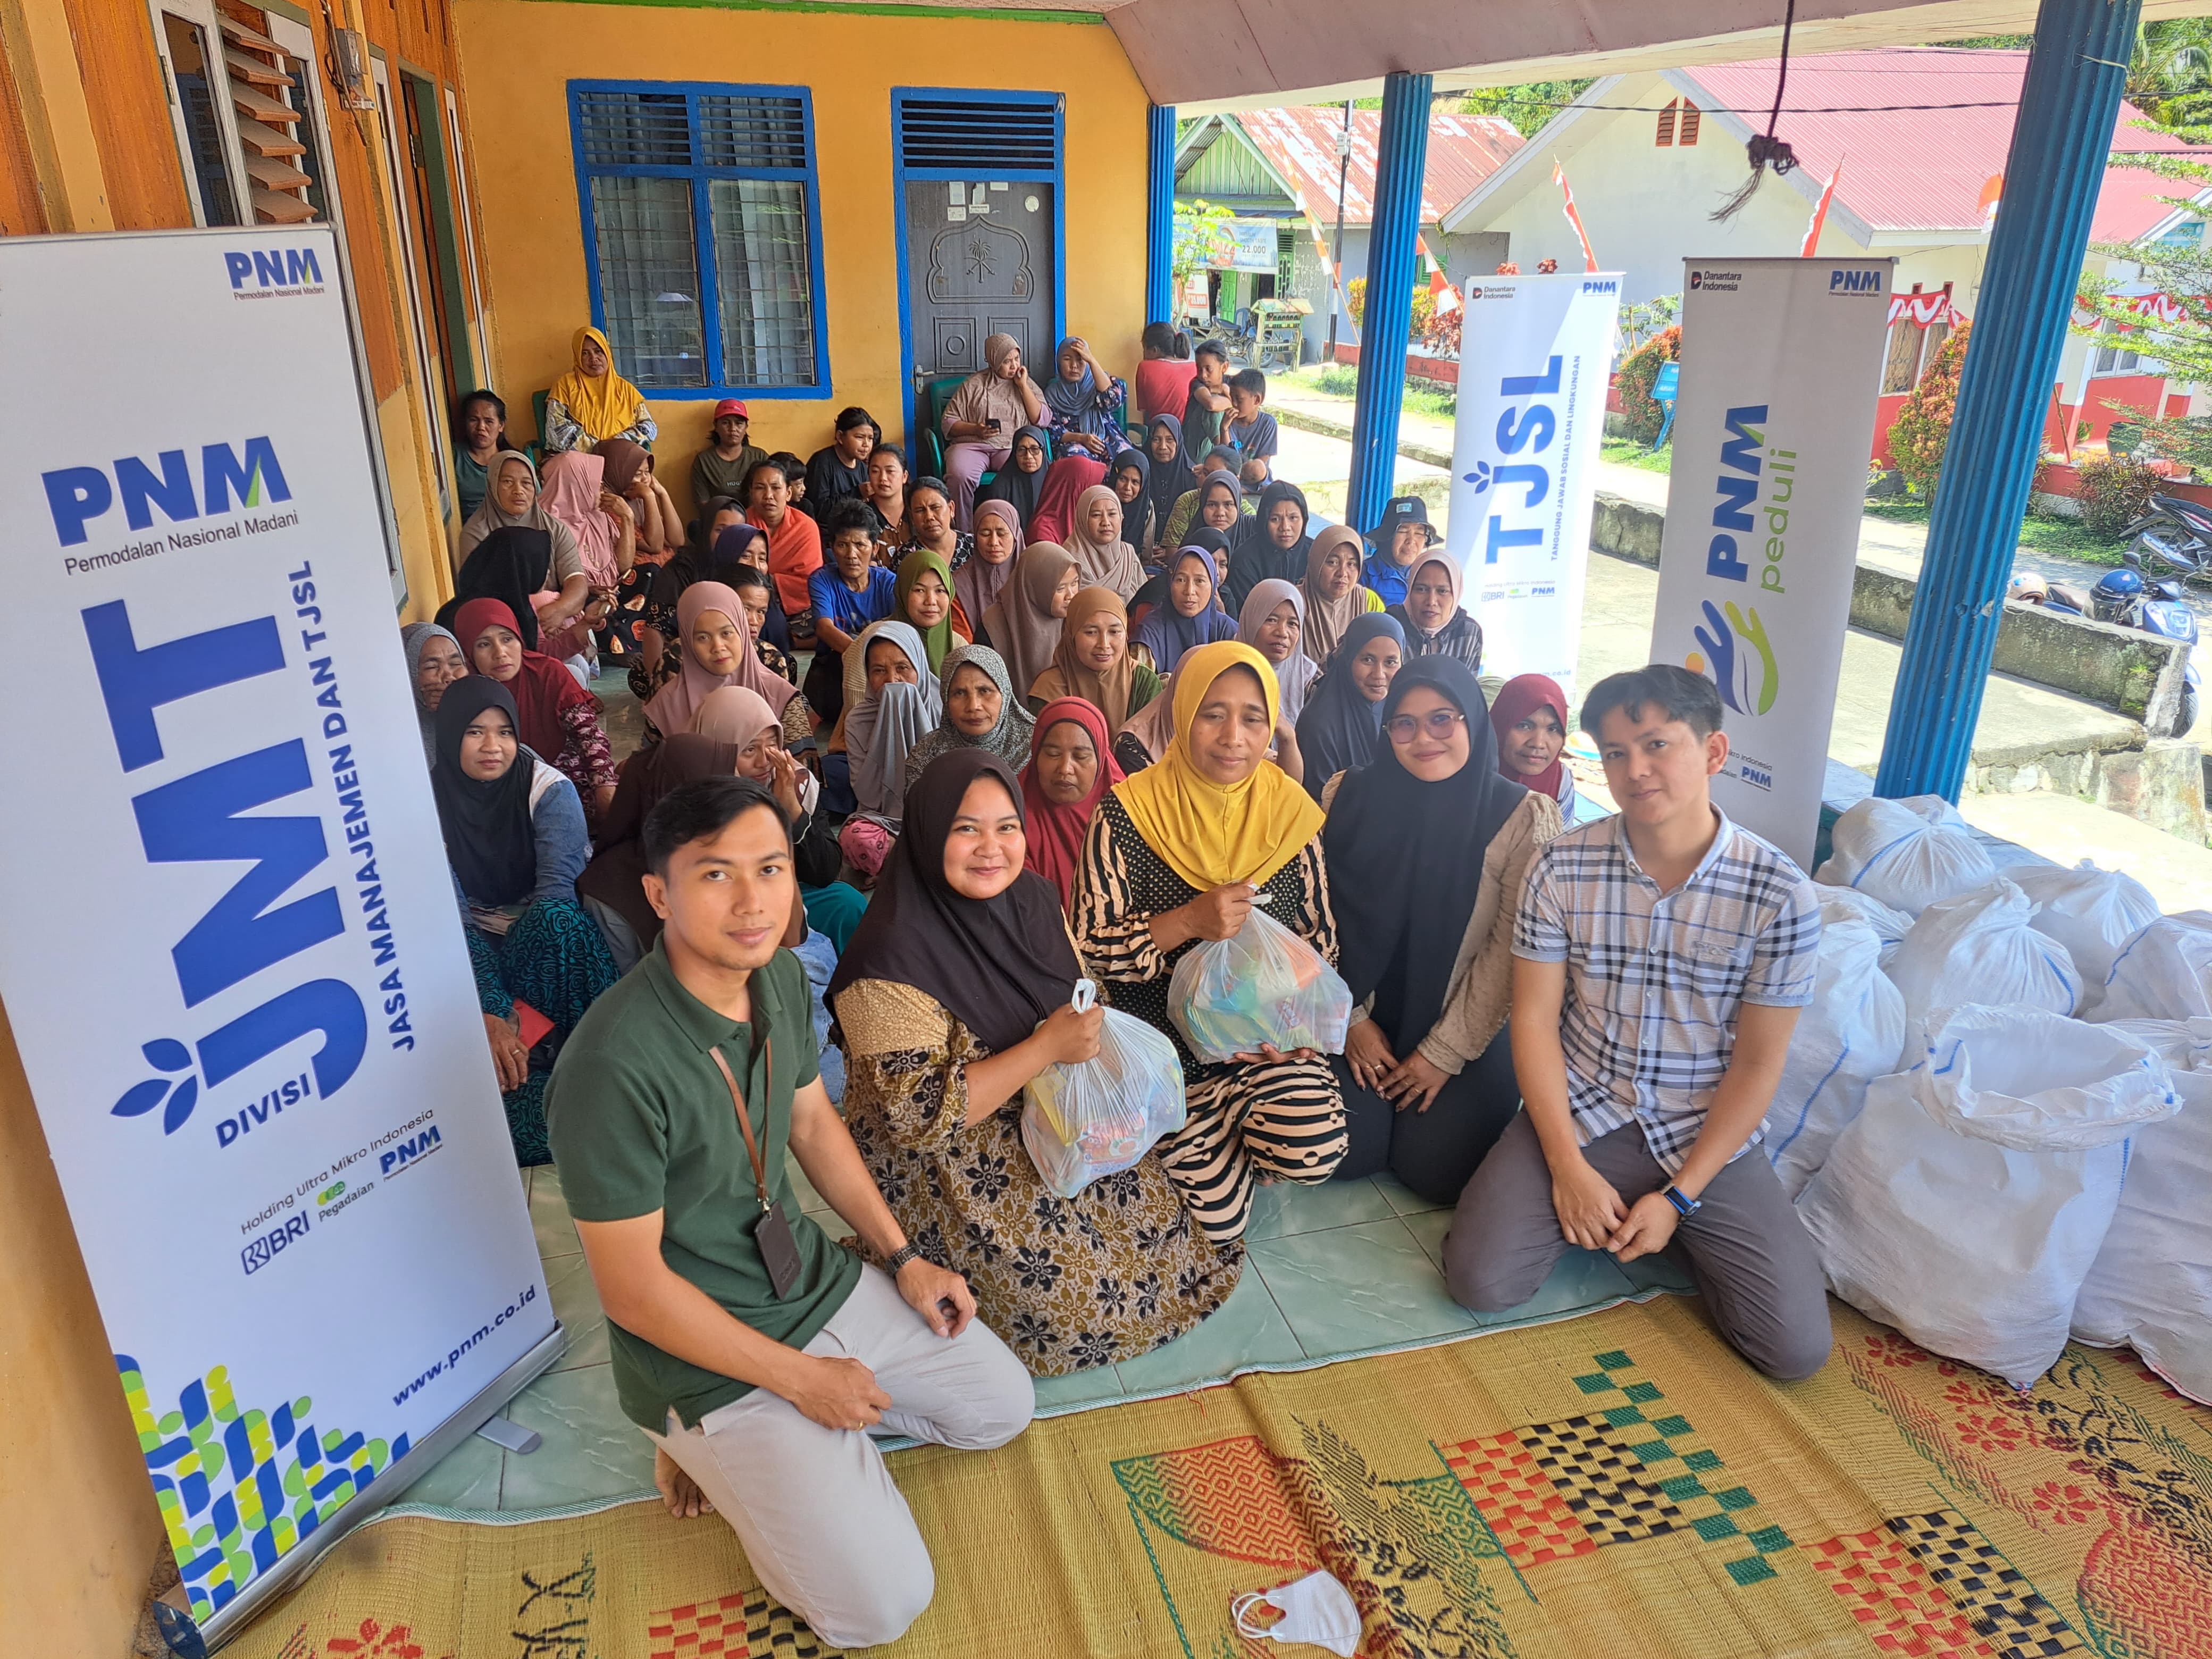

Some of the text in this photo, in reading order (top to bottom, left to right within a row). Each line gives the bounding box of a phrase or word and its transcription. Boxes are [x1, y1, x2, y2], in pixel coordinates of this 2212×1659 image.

[224, 248, 323, 289] PNM
[1242, 245, 1266, 254] 22.000
[1704, 271, 1741, 280] Danantara
[1830, 270, 1881, 291] PNM
[233, 286, 324, 300] Permodalan Nasional Madani
[1583, 281, 1615, 294] PNM
[1703, 281, 1738, 291] Indonesia
[41, 435, 292, 547] PNM
[1485, 355, 1563, 564] TJSL
[1551, 355, 1580, 562] TANGGUNG JAWAB SOSIAL DAN LINGKUNGAN
[1706, 405, 1769, 583] PNM
[64, 509, 299, 576] Permodalan Nasional Madani
[1761, 448, 1797, 594] peduli
[1532, 586, 1555, 595] PNM
[1741, 754, 1772, 771] Indonesia
[1742, 766, 1772, 788] PNM
[288, 559, 414, 1052] JASA MANAJEMEN DAN TJSL
[80, 599, 367, 1100] JMT
[215, 1073, 311, 1149] DIVISI
[241, 1109, 434, 1235] Holding Ultra Mikro Indonesia
[319, 1182, 374, 1222] Pegadaian
[379, 1125, 441, 1175] PNM
[392, 1285, 536, 1406] www.pnm.co.id
